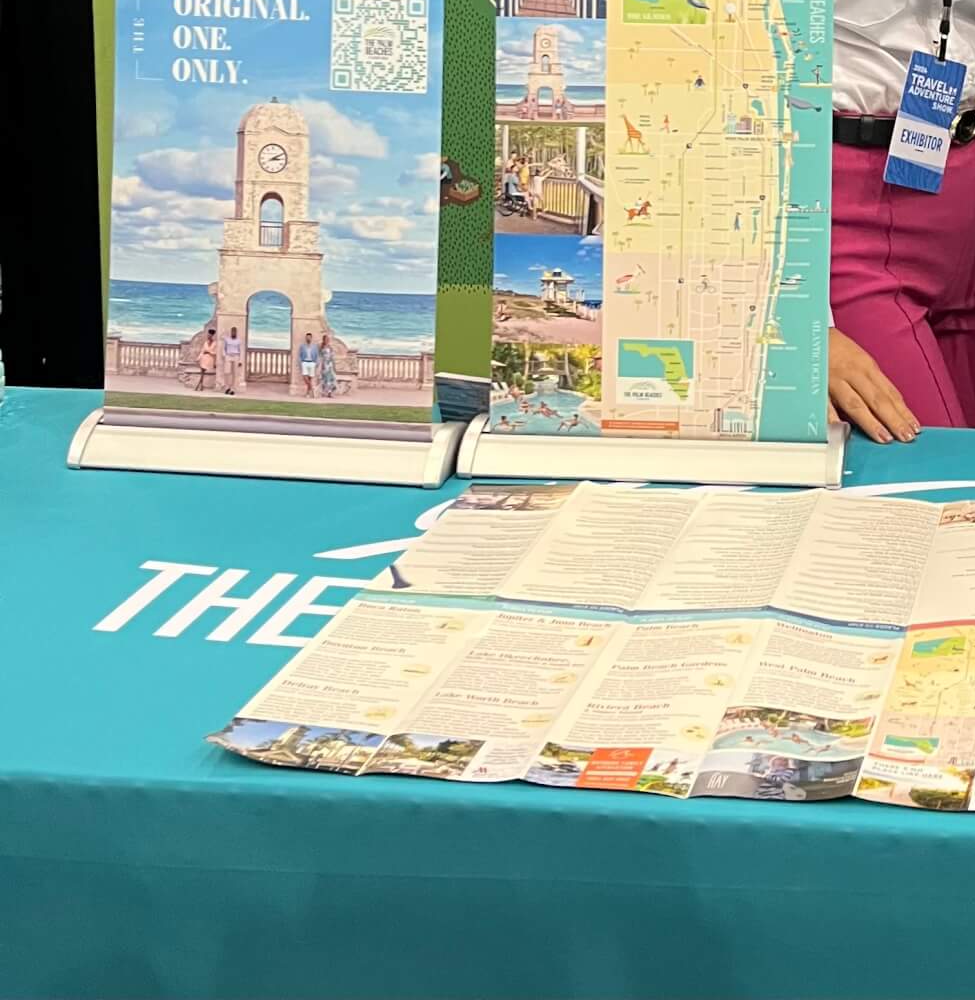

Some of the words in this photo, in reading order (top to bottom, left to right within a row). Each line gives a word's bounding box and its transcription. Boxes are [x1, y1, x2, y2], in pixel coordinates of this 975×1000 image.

[172, 24, 232, 52] ONE.
[171, 57, 248, 86] ONLY.
[911, 72, 948, 94] TRAVEL
[908, 85, 956, 106] ADVENTURE
[931, 101, 954, 114] SHOW
[900, 128, 944, 152] EXHIBITOR
[92, 560, 374, 648] THE
